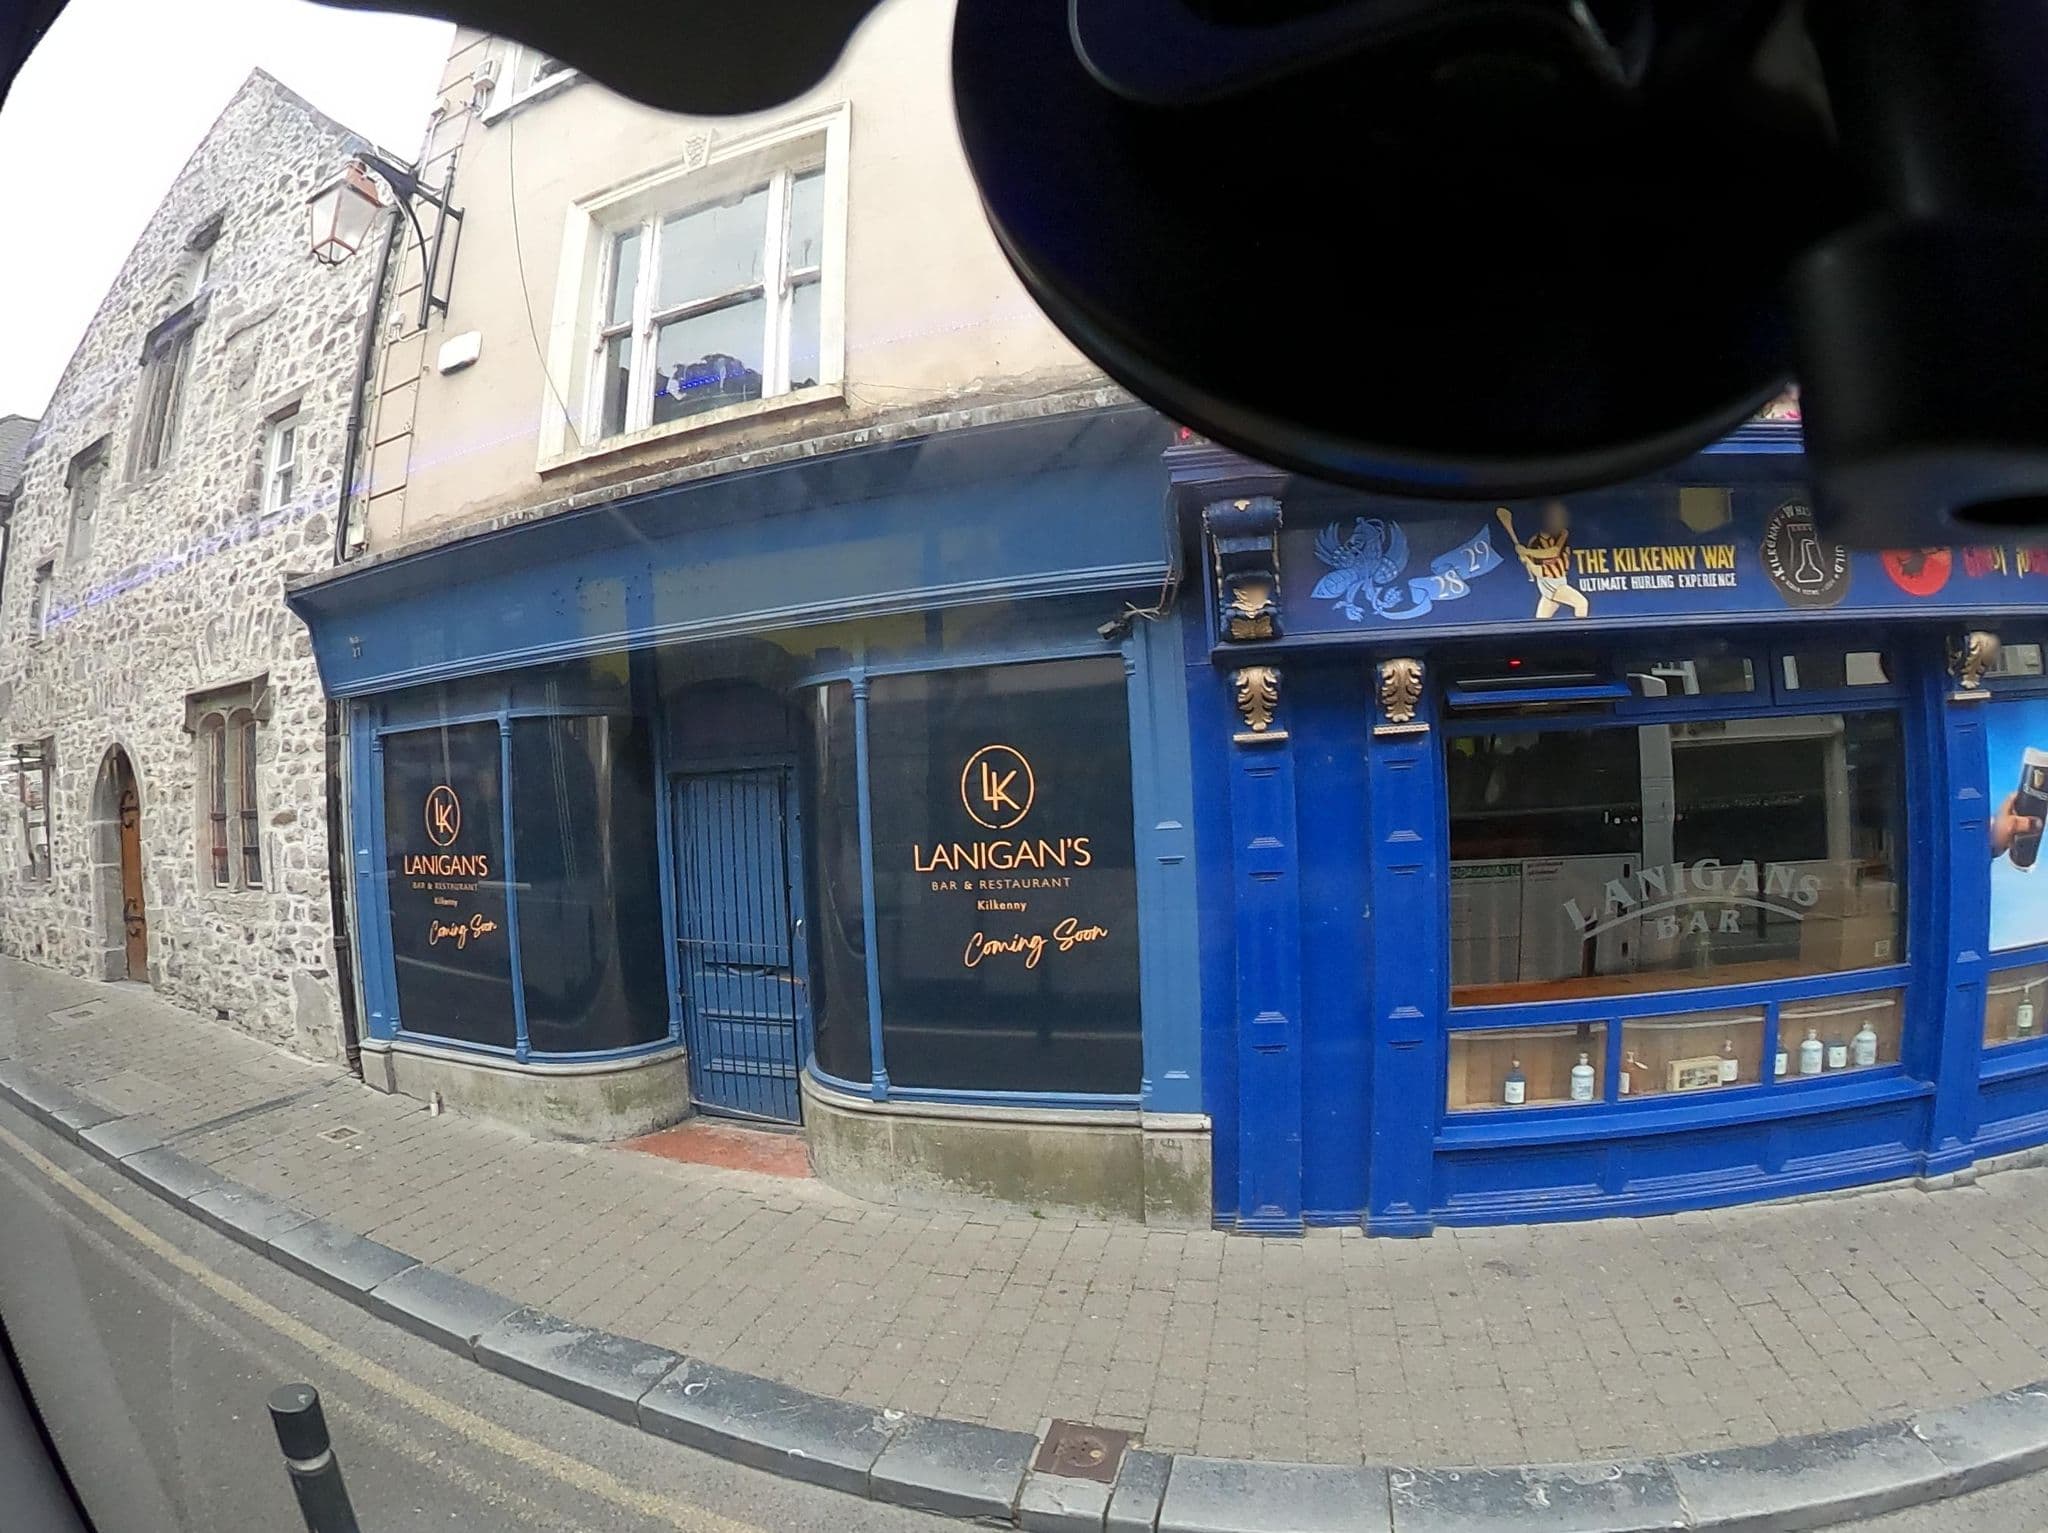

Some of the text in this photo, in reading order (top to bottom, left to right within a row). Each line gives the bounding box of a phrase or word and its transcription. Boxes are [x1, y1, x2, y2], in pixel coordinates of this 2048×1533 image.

[1437, 539, 1491, 599] 28 29
[1573, 545, 1736, 574] THE KILKENNY WAY
[1579, 573, 1737, 592] ULTIMATE HURLING EXPERIENCE
[404, 854, 488, 877] LANIGAN'S
[913, 838, 1092, 871] LANIGAN'S
[412, 881, 426, 890] BAR
[434, 882, 478, 892] RESTAURANT
[932, 877, 1072, 891] BAR & RESTAURANT
[1563, 858, 1823, 931] LANIGANS
[977, 899, 1028, 912] Kilkenny
[429, 914, 498, 949] Coming Soon
[1657, 909, 1742, 940] BAR
[965, 918, 1108, 969] Coming Soon
